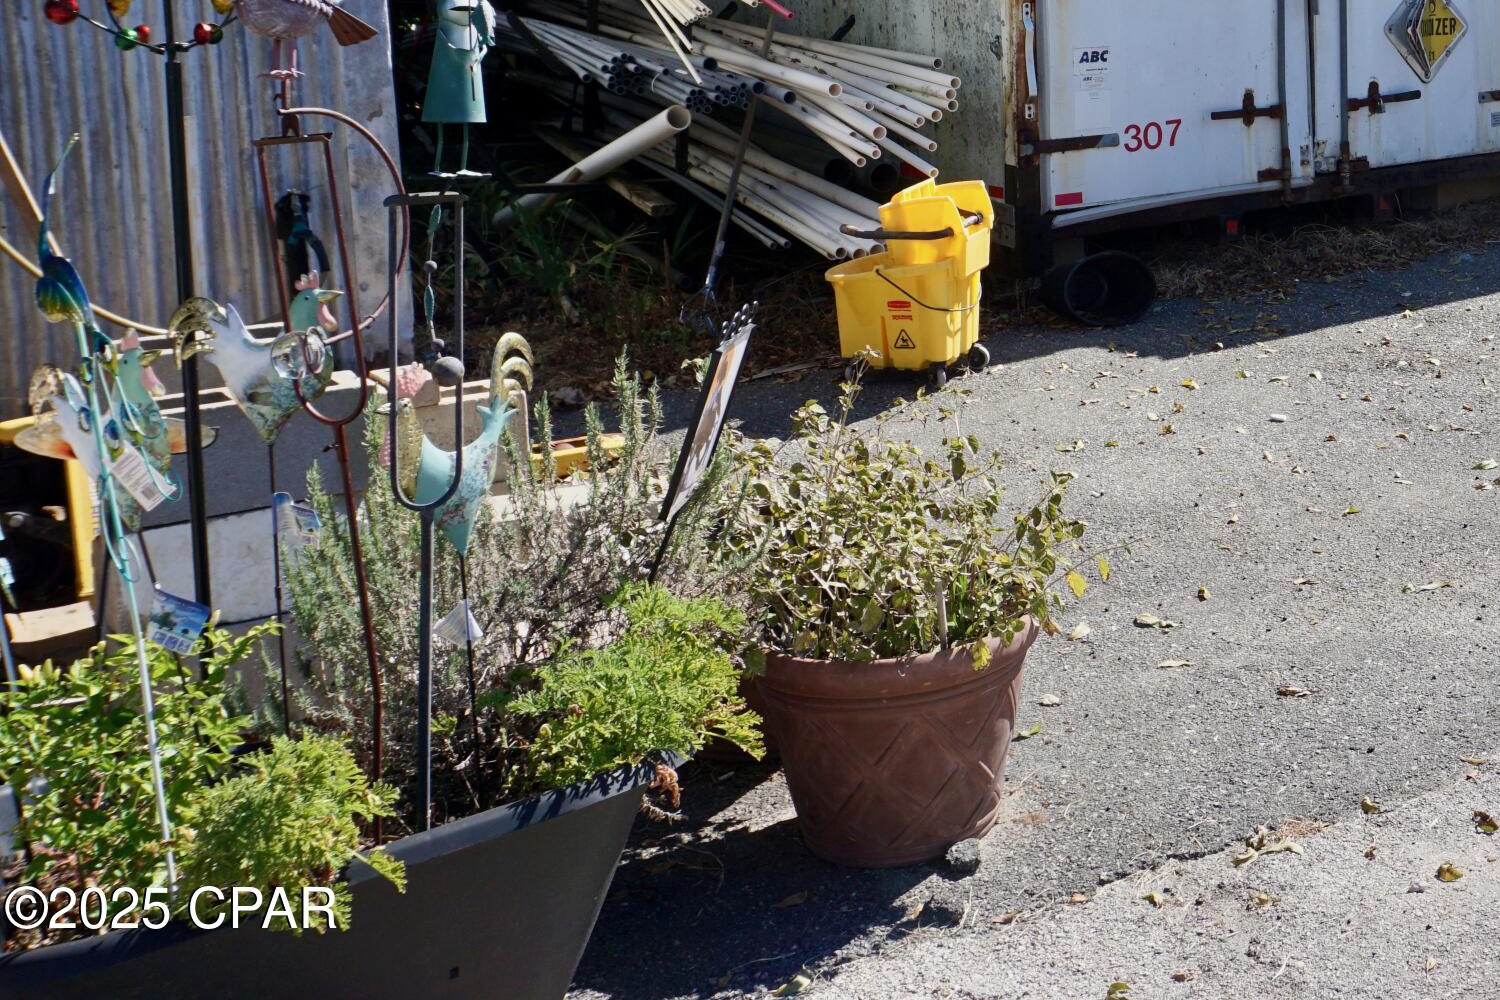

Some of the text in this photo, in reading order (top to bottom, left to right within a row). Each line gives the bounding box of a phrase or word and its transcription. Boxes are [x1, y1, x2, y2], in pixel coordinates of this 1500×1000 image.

[1421, 18, 1456, 35] IZER
[1079, 50, 1109, 64] ABC
[1124, 119, 1182, 153] 307
